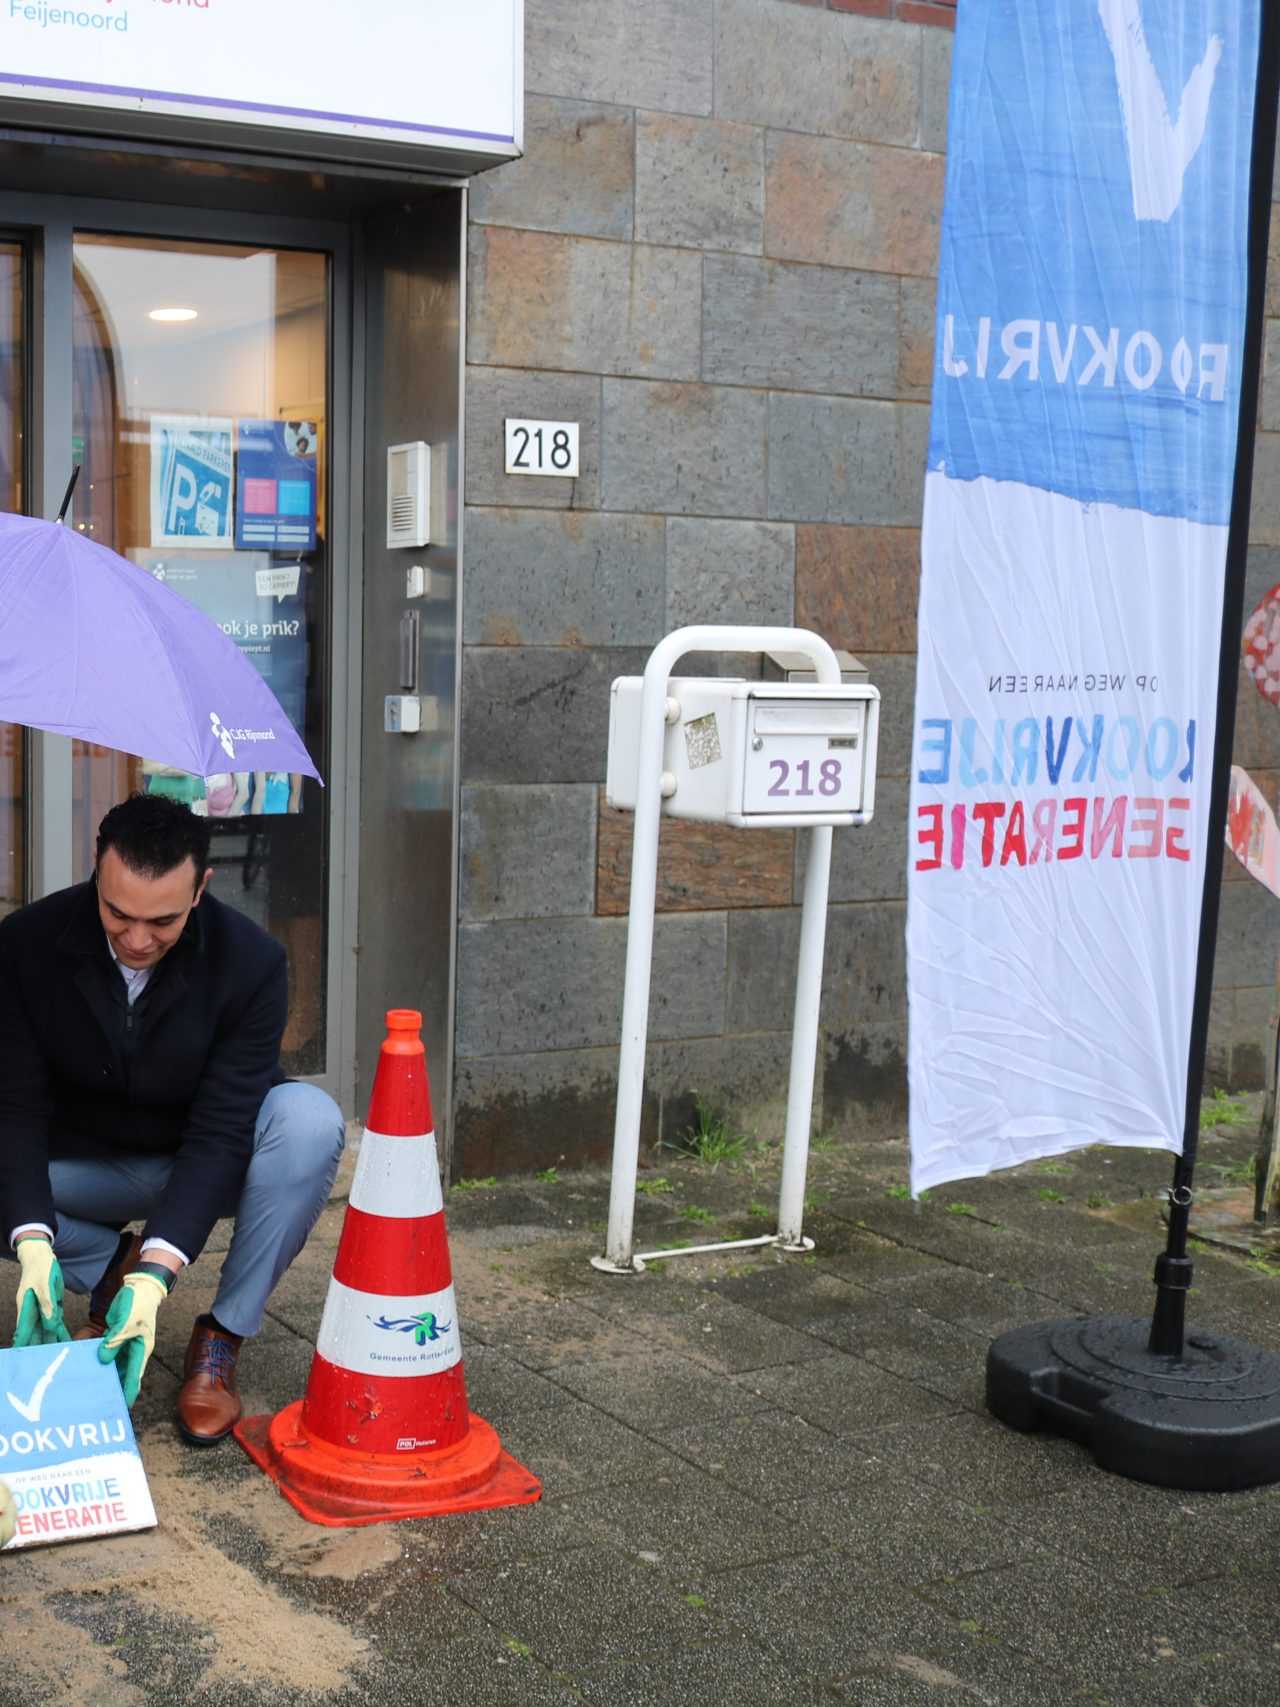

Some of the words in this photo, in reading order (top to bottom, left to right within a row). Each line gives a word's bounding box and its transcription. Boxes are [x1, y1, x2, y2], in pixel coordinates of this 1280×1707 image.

[9, 0, 128, 32] Feijenoord
[512, 427, 571, 469] 218
[216, 619, 241, 636] ok
[243, 619, 258, 639] je
[262, 620, 300, 639] prik?
[767, 759, 842, 797] 218
[370, 1352, 417, 1362] Gemeente
[50, 1471, 72, 1479] NAAR
[12, 1477, 121, 1512] OOKVRIJE
[17, 1502, 128, 1536] ENERATIE
